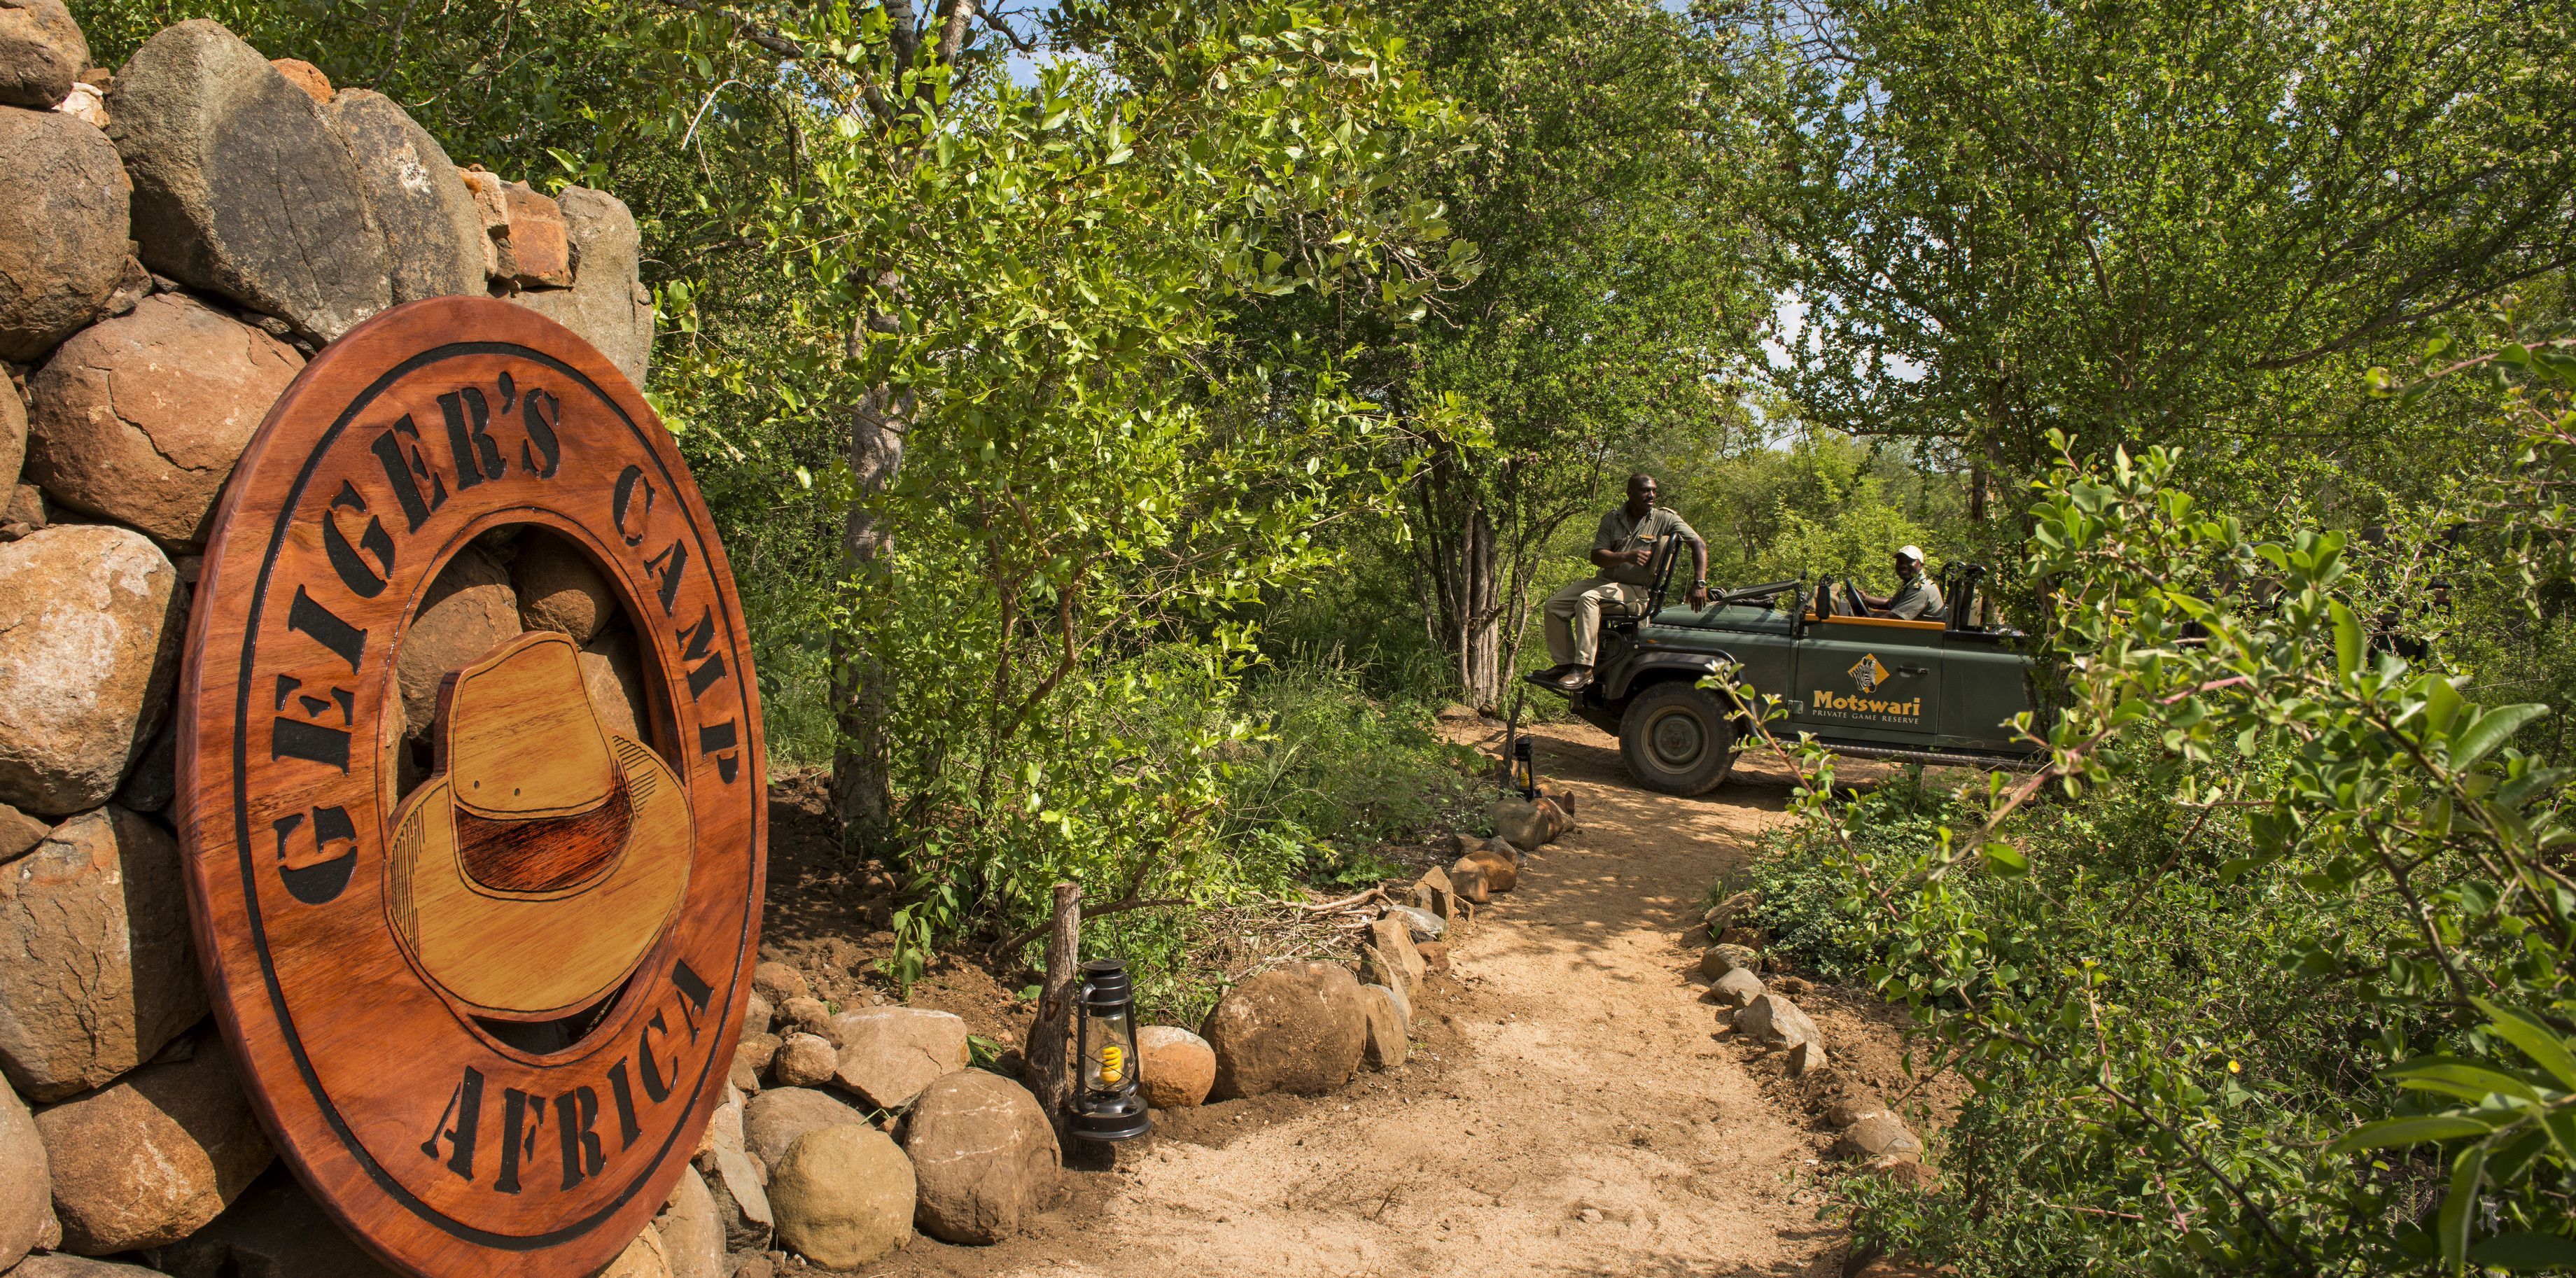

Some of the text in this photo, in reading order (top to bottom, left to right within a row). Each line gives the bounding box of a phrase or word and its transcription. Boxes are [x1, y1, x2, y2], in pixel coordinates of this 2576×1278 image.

[613, 465, 739, 785] CAMP
[1812, 710, 1847, 718] PRIVATE
[1882, 716, 1919, 724] RESERVE
[1813, 690, 1920, 716] Motswari
[421, 959, 714, 1195] AFRICA
